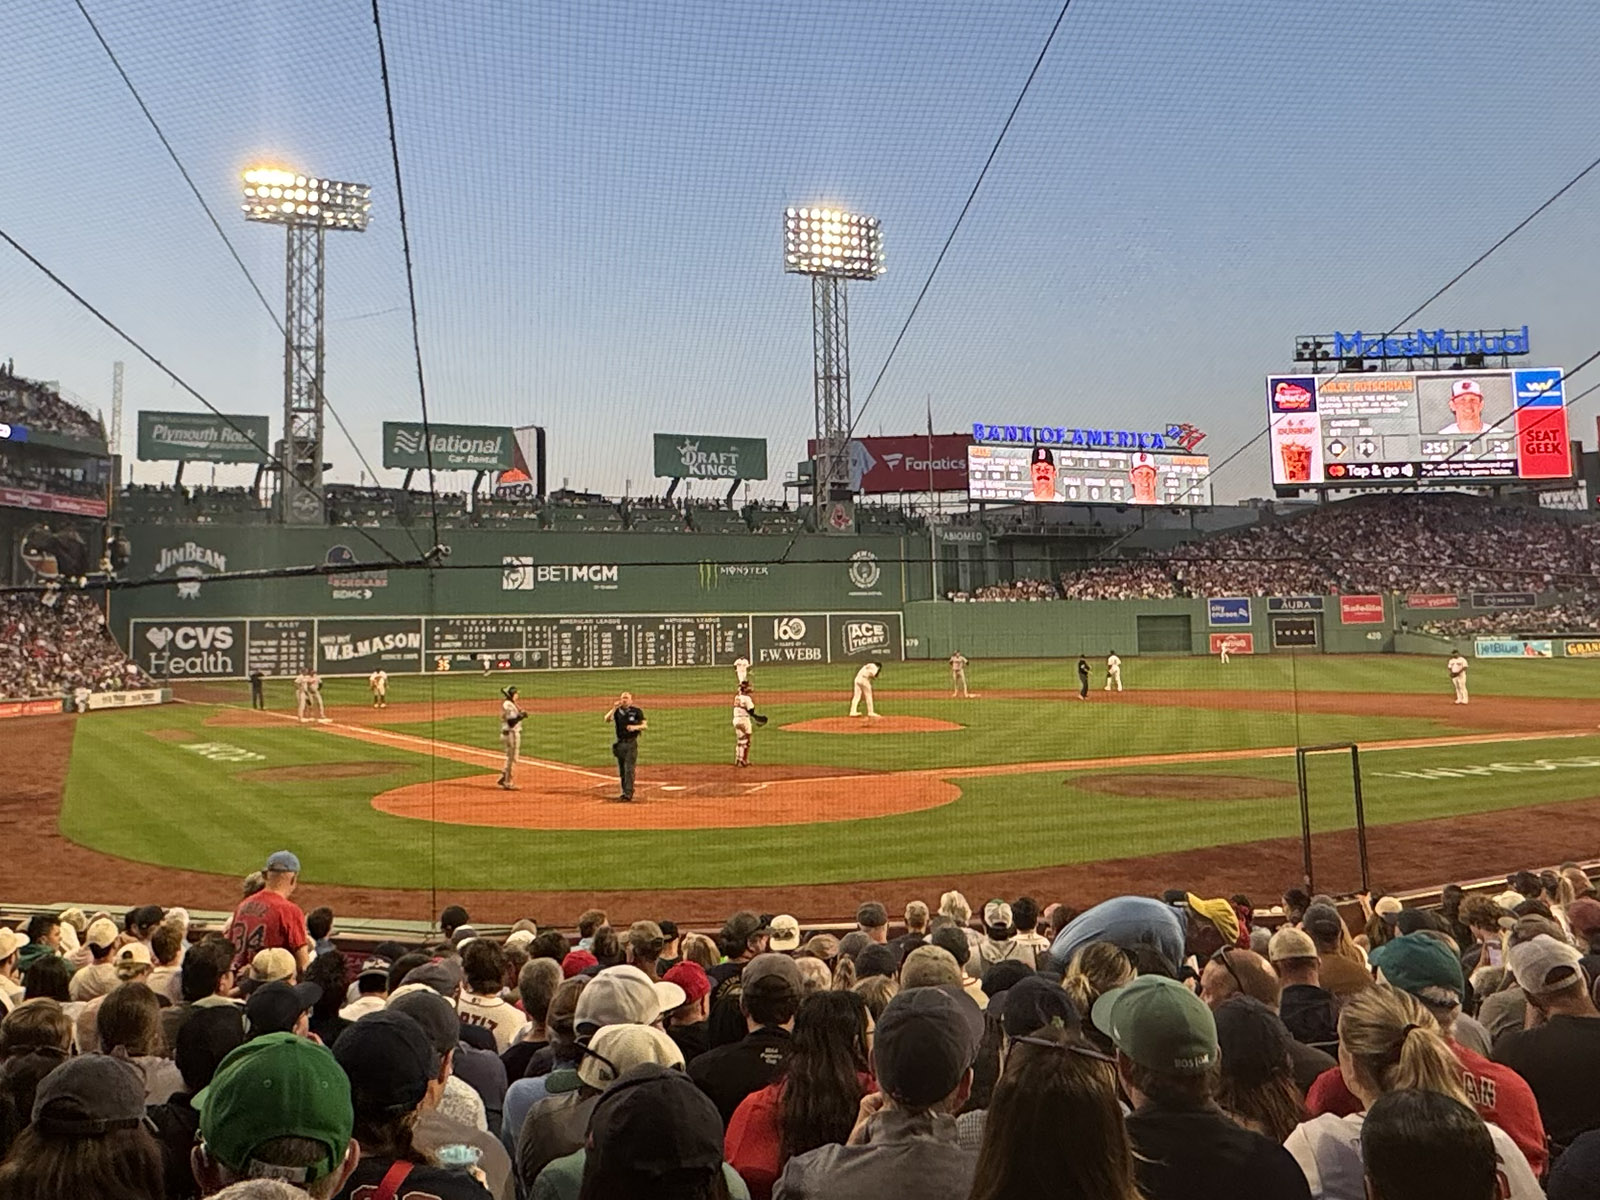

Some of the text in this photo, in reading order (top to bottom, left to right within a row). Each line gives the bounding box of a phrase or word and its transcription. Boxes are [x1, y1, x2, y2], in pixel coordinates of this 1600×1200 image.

[1334, 326, 1528, 358] MassMutual
[152, 424, 218, 441] Plymouth
[973, 422, 1167, 449] BANK OF AMERICA
[1526, 429, 1560, 441] SEAT
[419, 434, 502, 454] National
[1525, 443, 1563, 455] GEEK
[449, 454, 498, 464] Car Rental
[681, 451, 739, 466] DRAFT
[905, 457, 966, 471] Fanatics
[689, 464, 738, 477] KINGS
[1346, 464, 1400, 478] Tap & go
[1069, 486, 1121, 501] 0 0 2
[943, 532, 982, 542] ABIOMED
[155, 542, 227, 573] JIM BEAM
[537, 565, 619, 582] BETMGM
[720, 566, 769, 576] MONSTER
[773, 618, 806, 641] 160
[852, 623, 885, 637] ACE
[175, 626, 233, 650] CVS
[852, 635, 885, 647] TICKET
[760, 647, 822, 662] F.W. WEBB
[1481, 643, 1518, 654] jetBlue
[1567, 643, 1600, 655] GRAN
[149, 651, 233, 674] Health
[437, 659, 451, 671] 35
[232, 922, 268, 951] 34
[460, 1011, 499, 1031] RTIZ
[1462, 1071, 1496, 1109] AN
